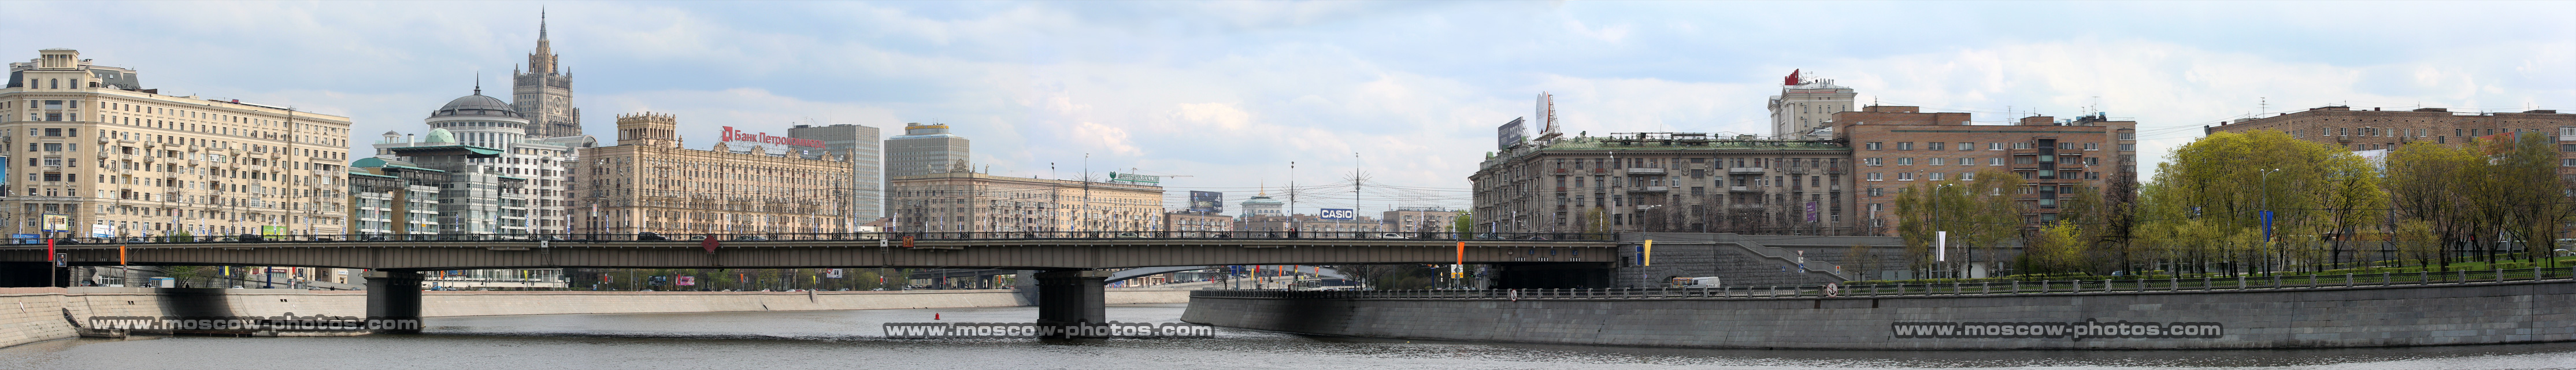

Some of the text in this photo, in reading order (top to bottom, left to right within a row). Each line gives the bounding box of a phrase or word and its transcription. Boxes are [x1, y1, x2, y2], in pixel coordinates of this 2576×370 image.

[735, 130, 825, 150] Банк Петрокоммерц
[1321, 210, 1352, 219] CASIO
